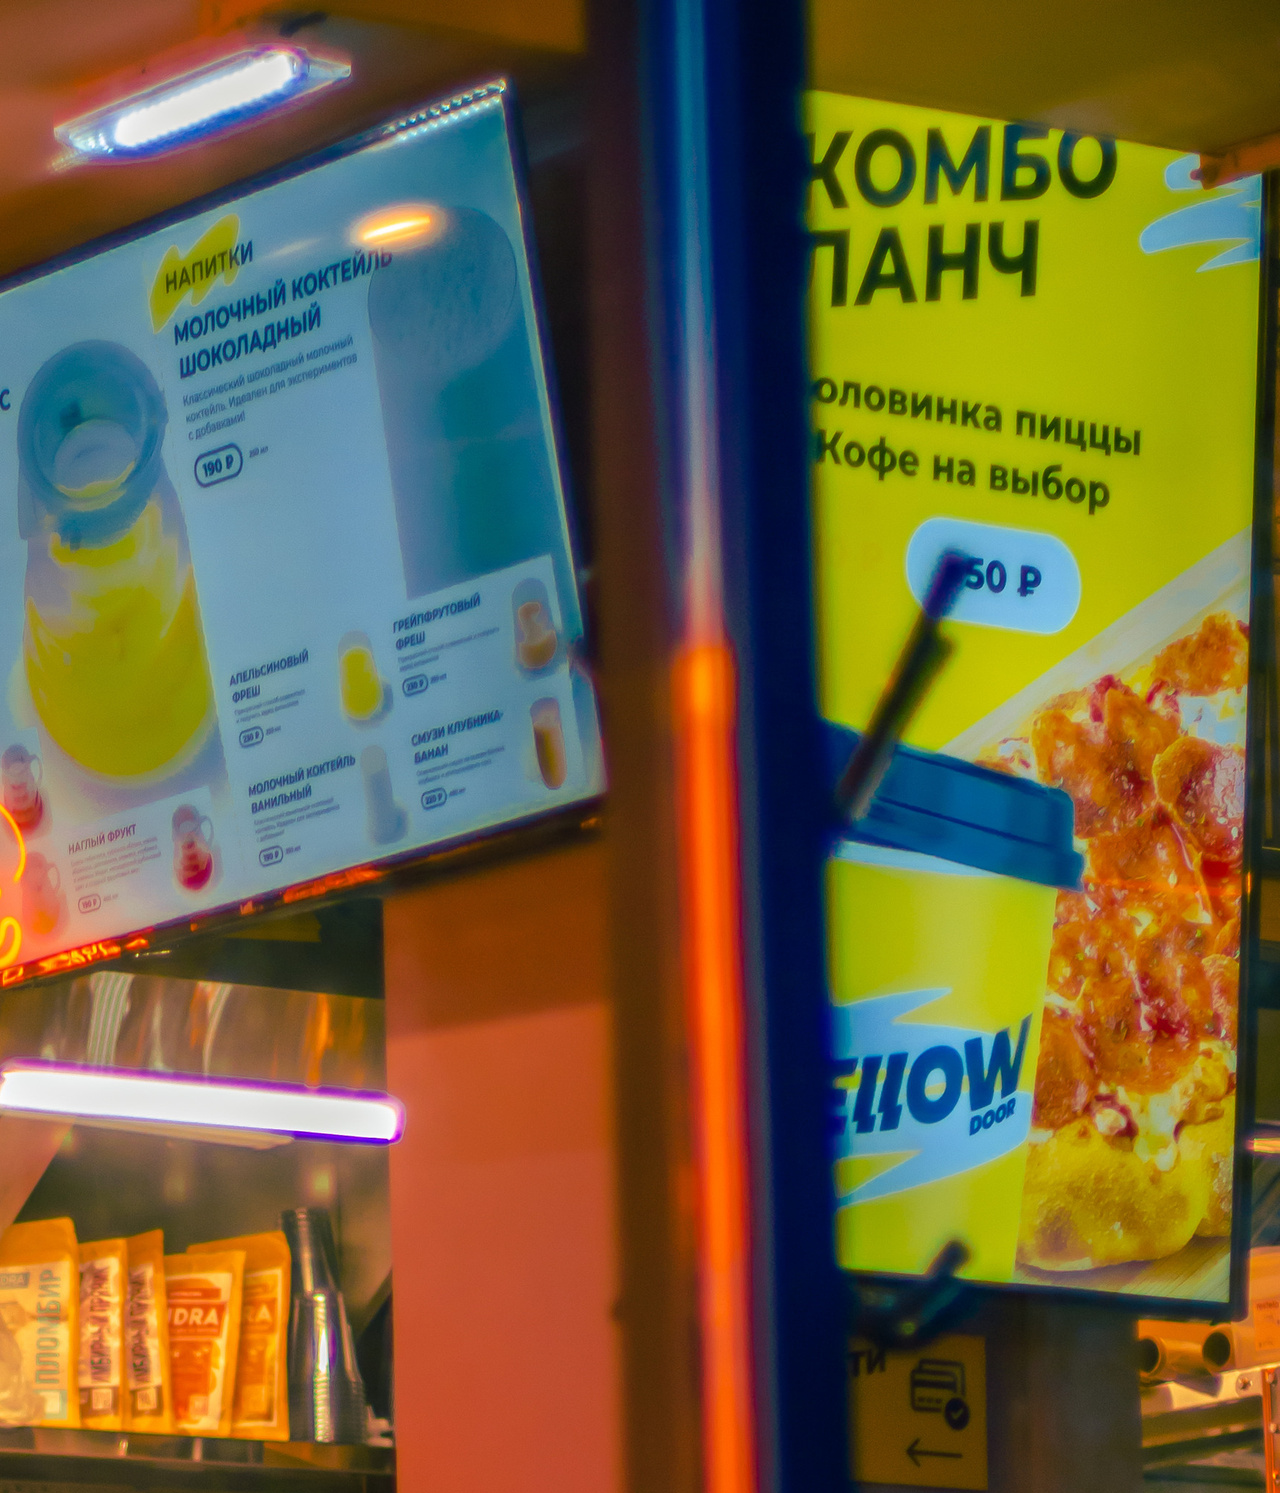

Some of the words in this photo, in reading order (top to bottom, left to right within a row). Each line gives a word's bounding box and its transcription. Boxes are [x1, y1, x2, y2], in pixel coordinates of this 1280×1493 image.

[805, 123, 1118, 212] КОМБО
[165, 240, 253, 294] НАПИТКИ
[174, 278, 286, 346] МОЛОЧНЫЙ
[291, 247, 393, 300] КОКТЕЙЛЬ
[179, 301, 321, 380] ШОКОЛАДНЫЙ
[183, 374, 245, 407] Классический
[247, 352, 305, 383] шоколадный
[306, 335, 353, 361] молочный
[228, 386, 268, 408] Идеален
[269, 381, 286, 395] для
[287, 353, 358, 386] экспериментов
[813, 376, 1002, 433] оловинка
[1016, 408, 1142, 457] пиццы
[202, 458, 223, 478] 190
[818, 429, 920, 481] Кофе
[933, 452, 977, 487] на
[990, 463, 1111, 516] выбор
[958, 556, 1007, 594] 50
[393, 591, 481, 634] ГРЕЙПФРУТОВЫЙ
[395, 630, 426, 650] ФРЕШ
[230, 648, 309, 686] АПЕЛЬСИНОВЫЙ
[232, 685, 261, 704] ФРЕШ
[411, 726, 445, 747] СМУЗИ
[414, 743, 449, 766] БАНАН
[248, 767, 305, 798] МОЛОЧНЫЙ
[306, 754, 356, 779] КОКТЕЙЛЬ
[251, 783, 312, 815] ВАНИЛЬНЫЙ
[68, 830, 106, 855] НАГЛЫЙ
[107, 823, 137, 843] ФРУКТ
[969, 1096, 1017, 1137] DOOR
[35, 1269, 61, 1385] ПЛОМБИР
[168, 1306, 219, 1326] DRA
